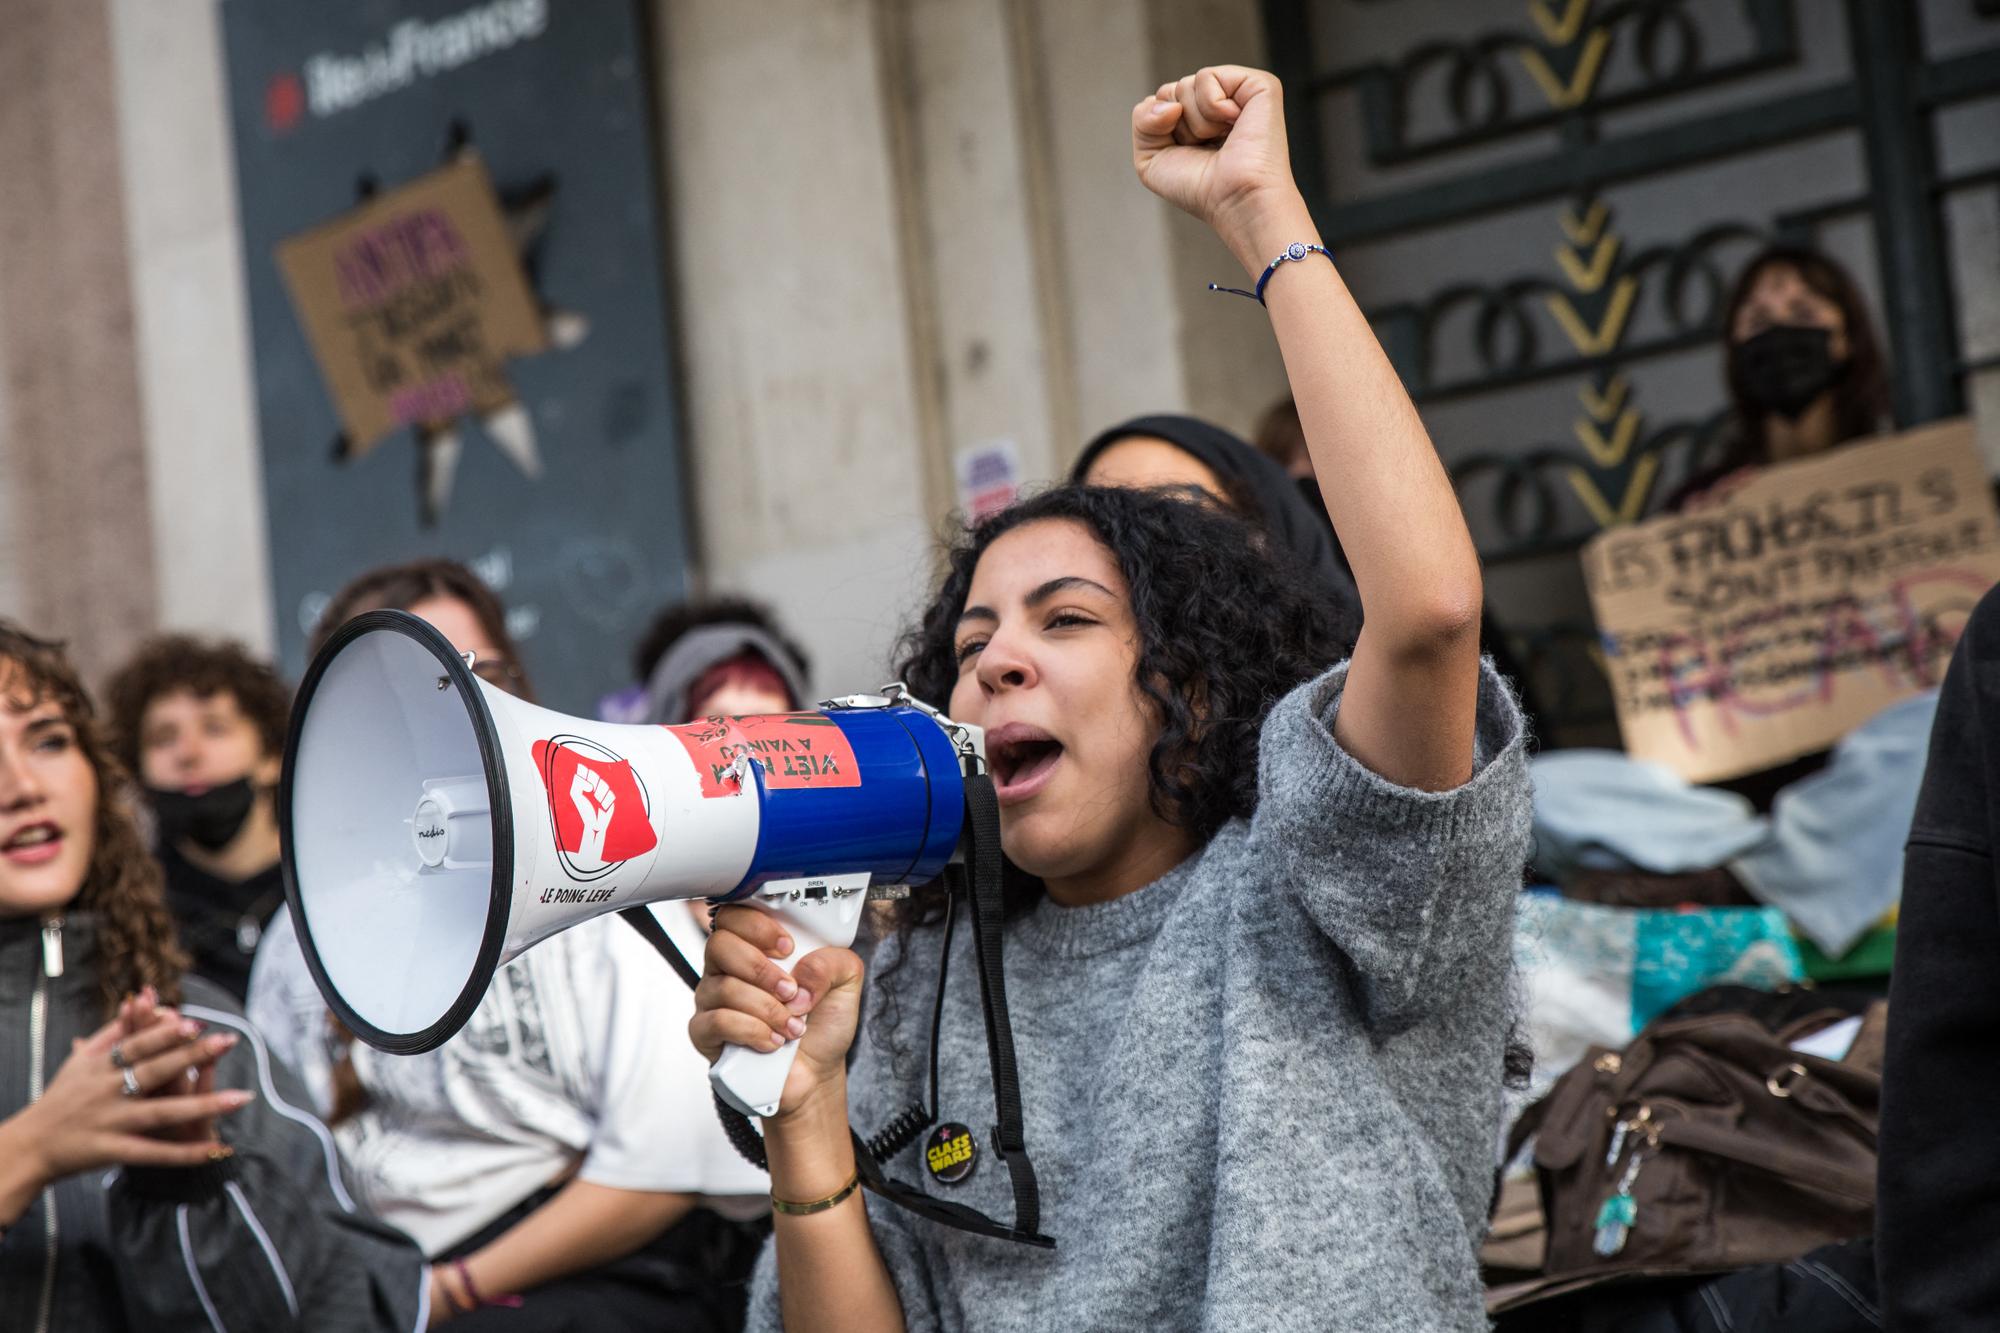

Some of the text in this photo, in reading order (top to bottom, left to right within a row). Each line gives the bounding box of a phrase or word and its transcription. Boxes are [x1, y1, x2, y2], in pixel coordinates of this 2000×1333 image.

[541, 886, 617, 904] LE POING LEVÉ
[927, 1132, 970, 1162] CLASS
[929, 1145, 972, 1173] WARS
